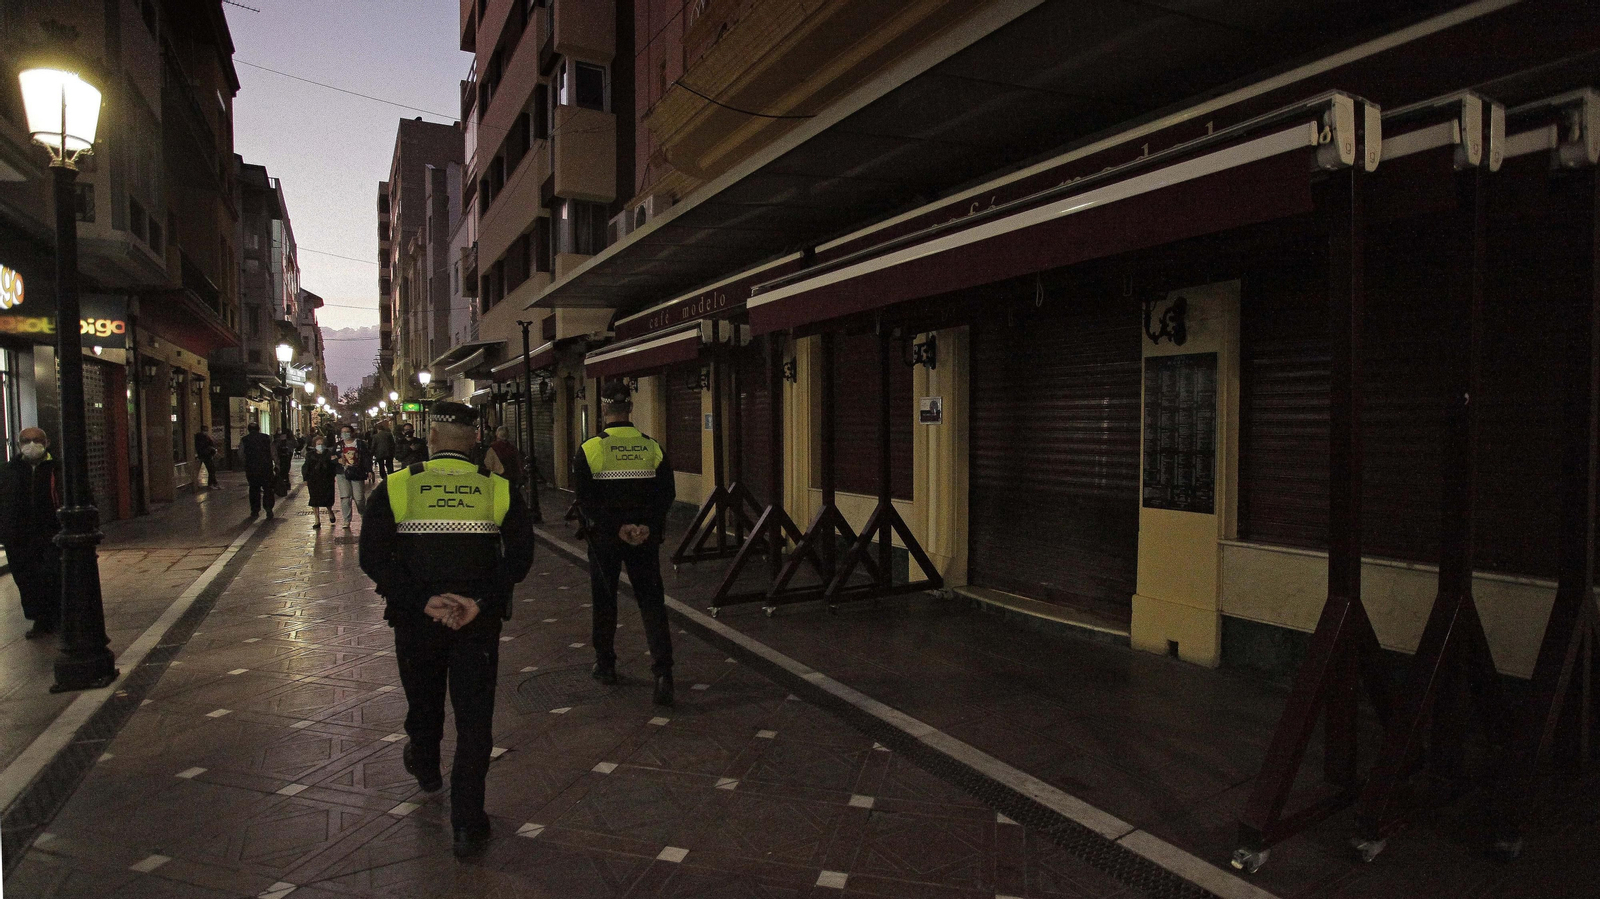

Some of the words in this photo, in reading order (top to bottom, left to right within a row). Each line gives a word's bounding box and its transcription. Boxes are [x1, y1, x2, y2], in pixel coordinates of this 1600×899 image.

[649, 309, 669, 329] café
[682, 292, 725, 318] modelo
[420, 485, 482, 495] PLICIA
